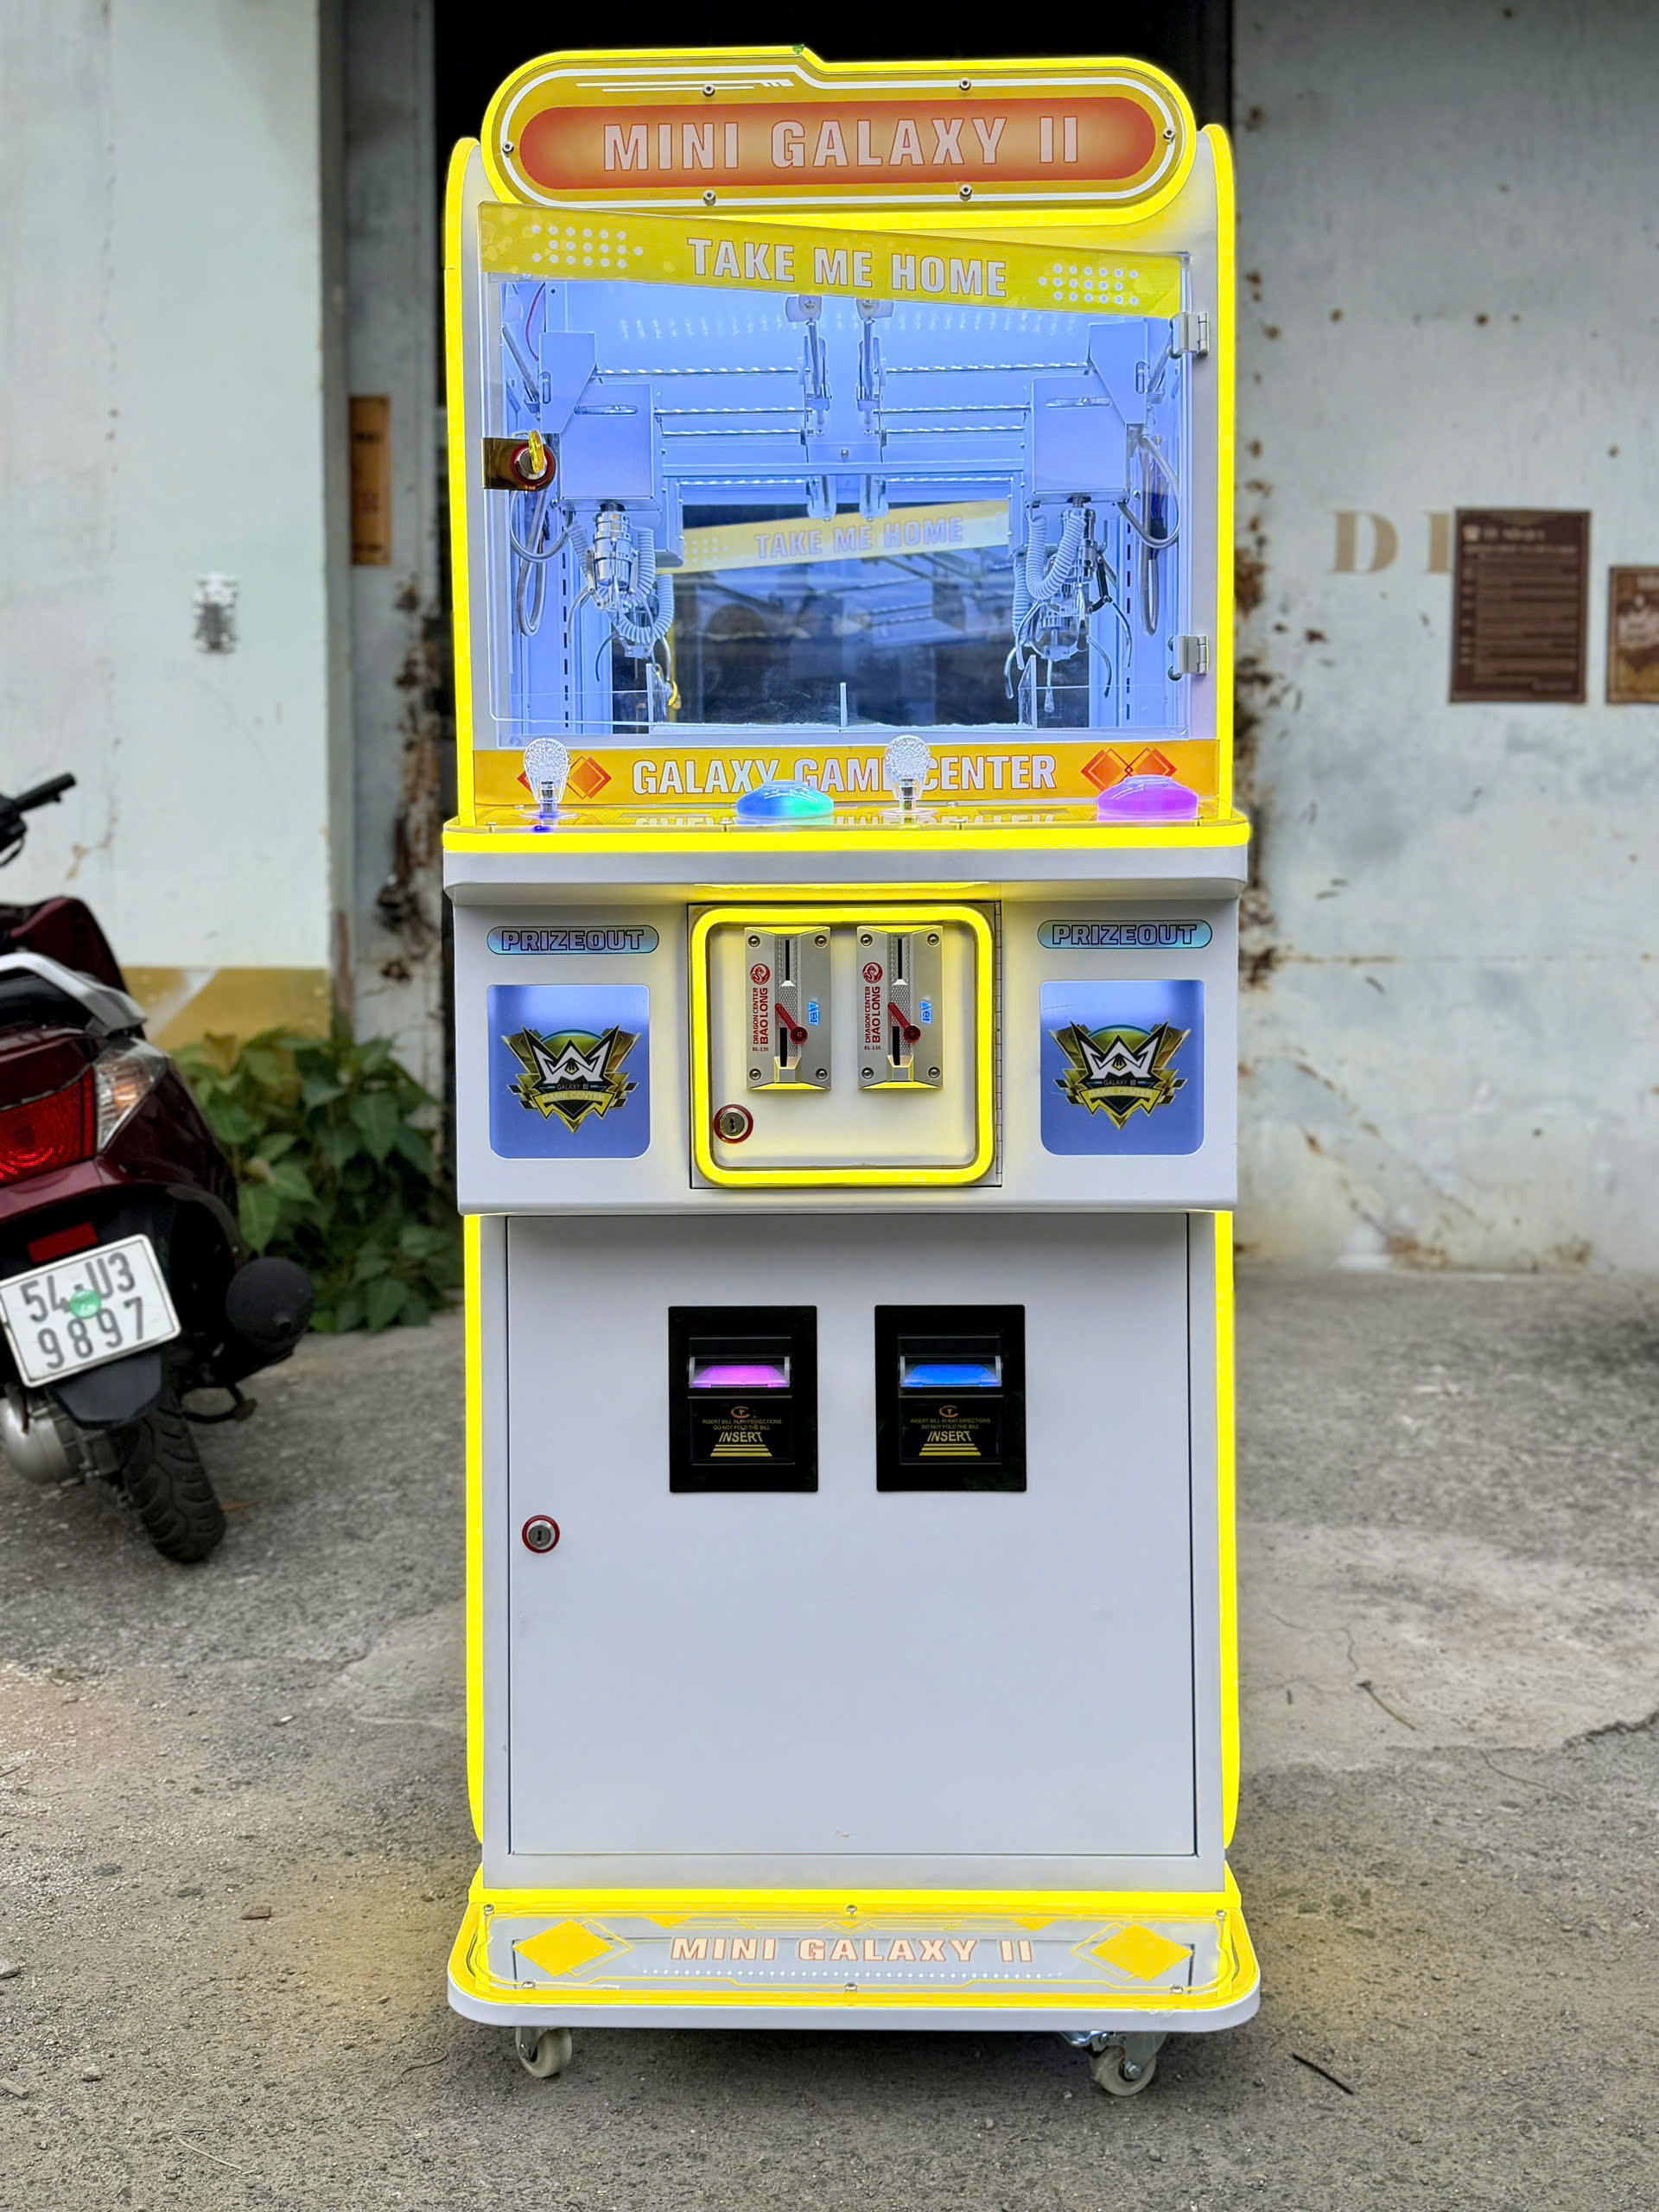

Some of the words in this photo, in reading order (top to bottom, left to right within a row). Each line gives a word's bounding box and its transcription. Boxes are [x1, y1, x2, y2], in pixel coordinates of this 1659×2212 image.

[603, 121, 740, 171] MINI
[771, 118, 1007, 168] GALAXY
[1039, 116, 1079, 164] II
[687, 238, 795, 283] TAKE
[813, 247, 874, 288] ME
[891, 253, 1007, 298] HOME
[754, 529, 823, 560] TAKE
[833, 524, 874, 553] ME
[883, 516, 964, 550] HOME
[632, 759, 780, 795] GALAXY
[501, 929, 645, 951] PRIZEOUT
[1052, 924, 1198, 945] PRIZEOUT
[760, 988, 768, 1017] LONG
[872, 987, 880, 1016] LONG
[36, 1296, 143, 1370] 9897
[718, 1431, 763, 1443] INSERT
[926, 1430, 972, 1442] INSERT
[670, 1936, 778, 1961] MINI
[798, 1937, 978, 1962] GALAXY
[998, 1938, 1035, 1963] II
